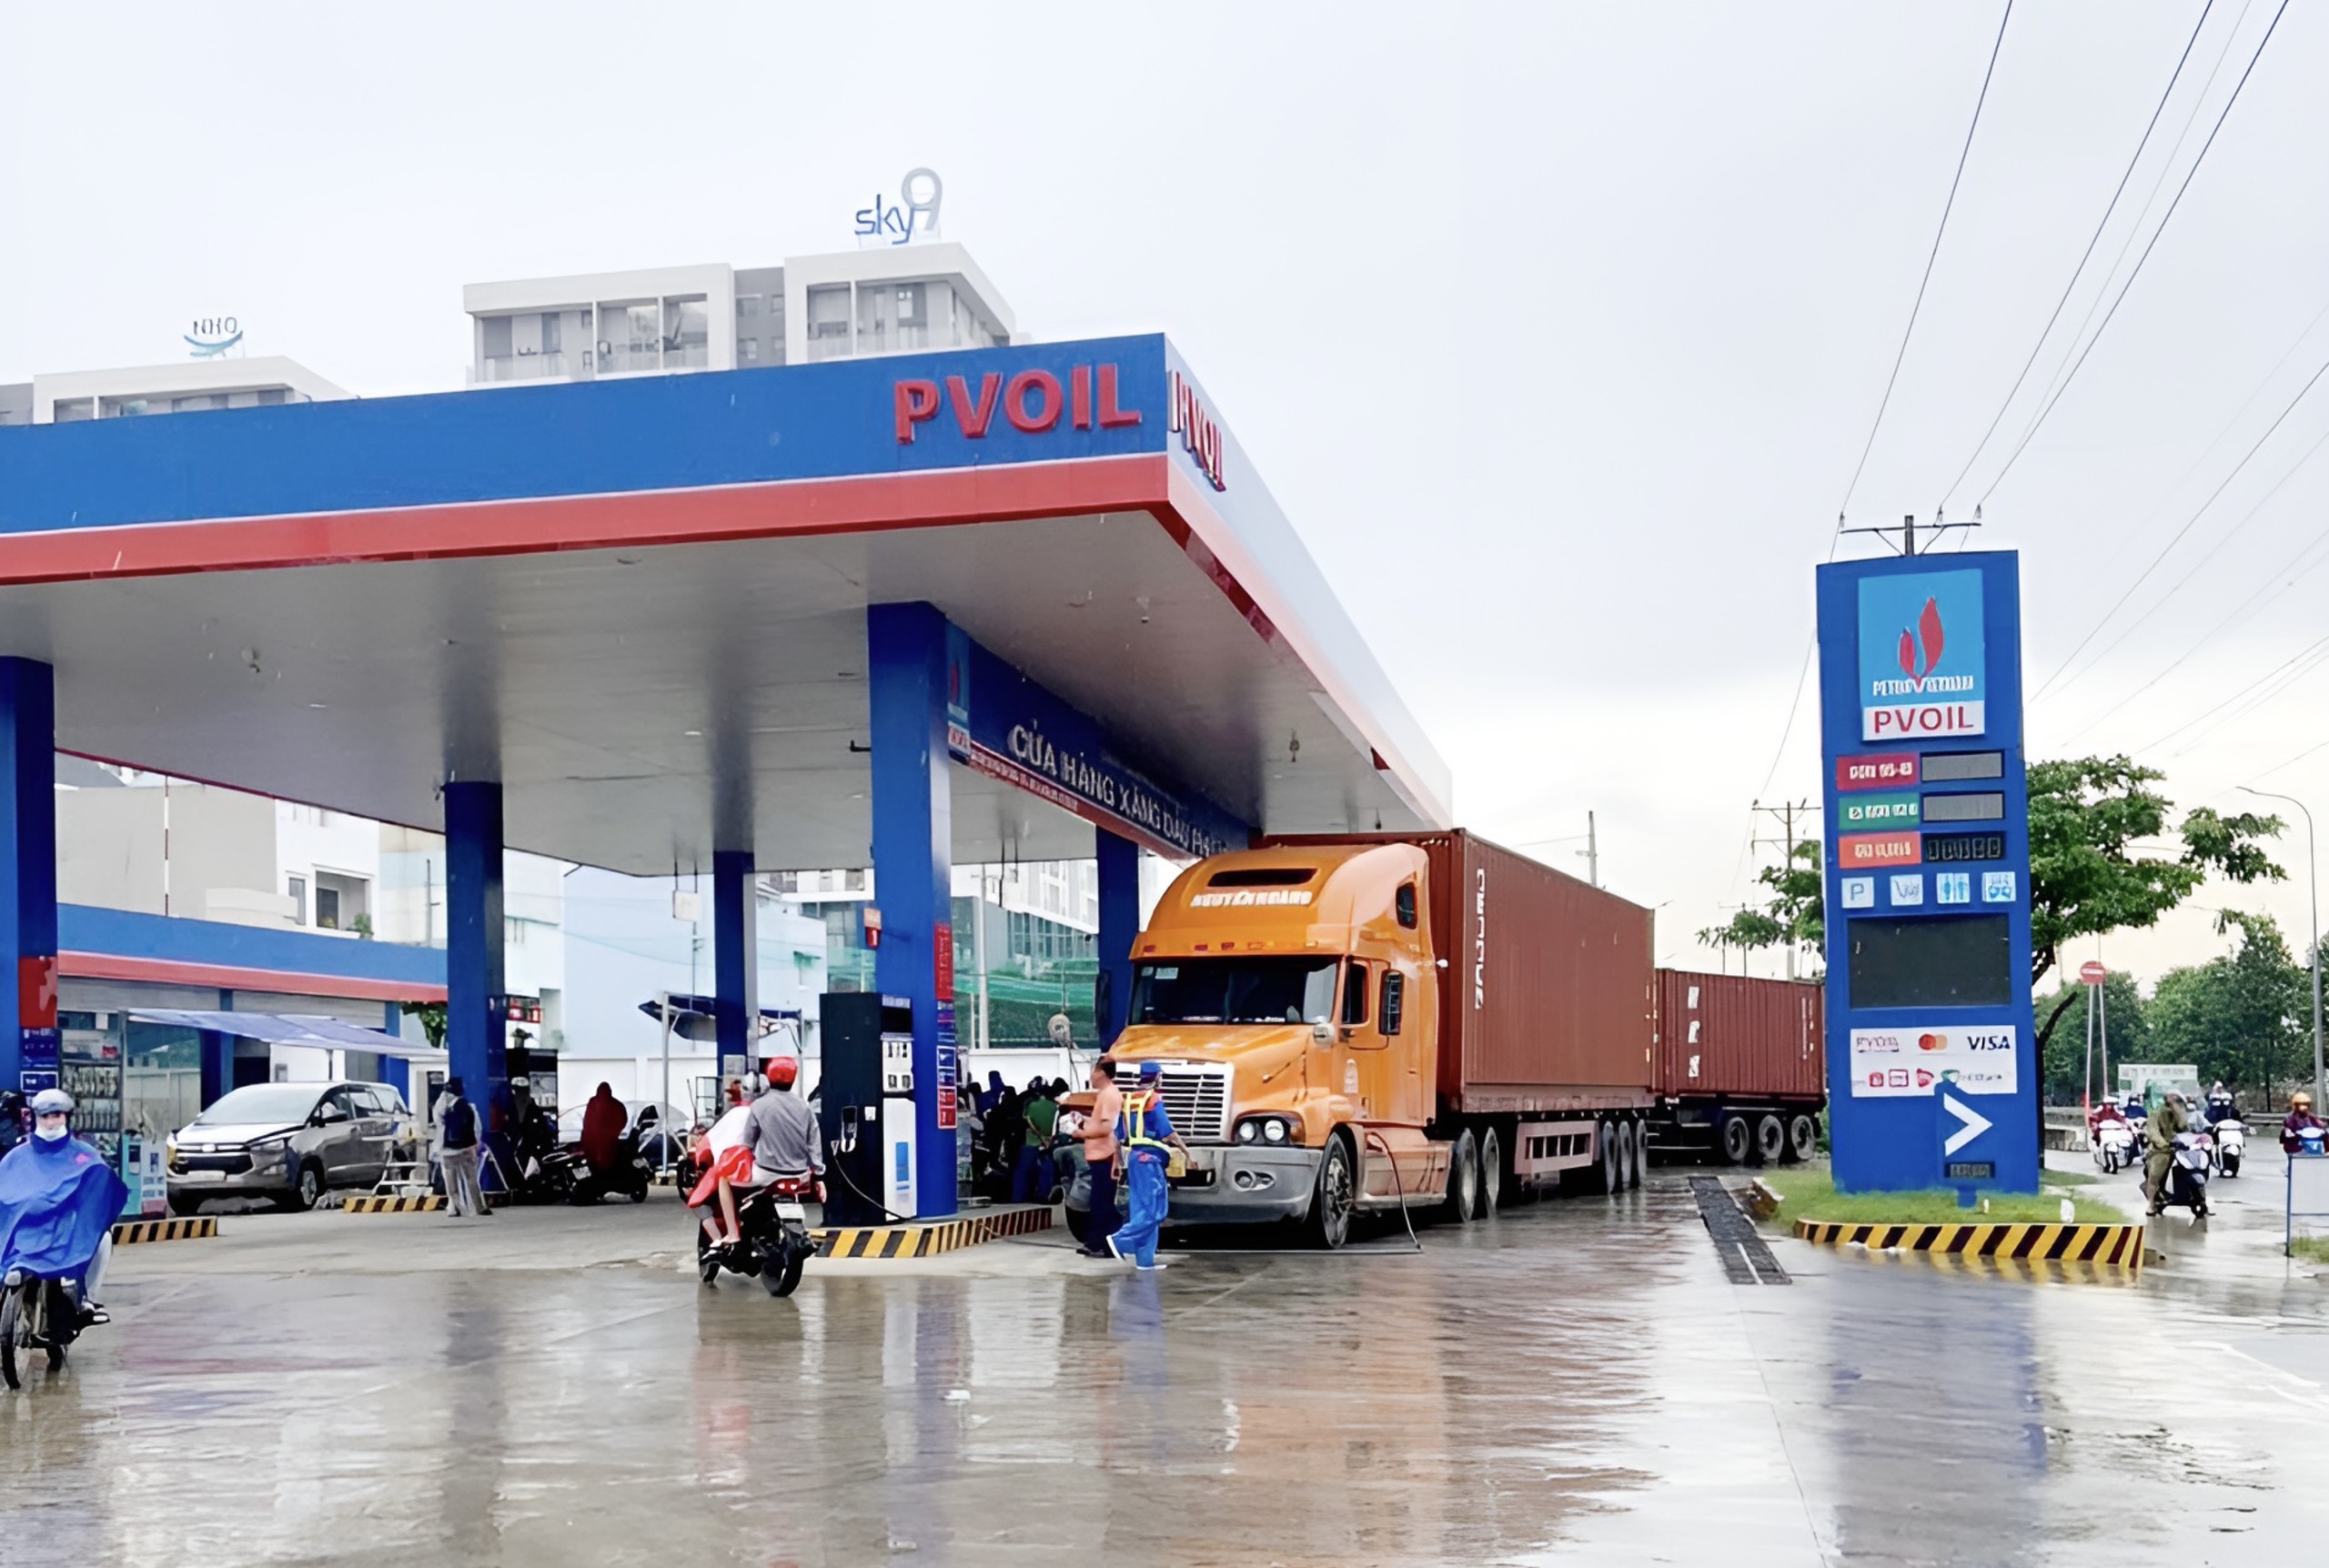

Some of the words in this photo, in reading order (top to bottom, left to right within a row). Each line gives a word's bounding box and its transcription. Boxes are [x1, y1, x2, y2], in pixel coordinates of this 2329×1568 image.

[894, 364, 1142, 446] PVOIL
[1874, 706, 1974, 734] PVOIL
[1967, 1035, 2011, 1051] VISA
